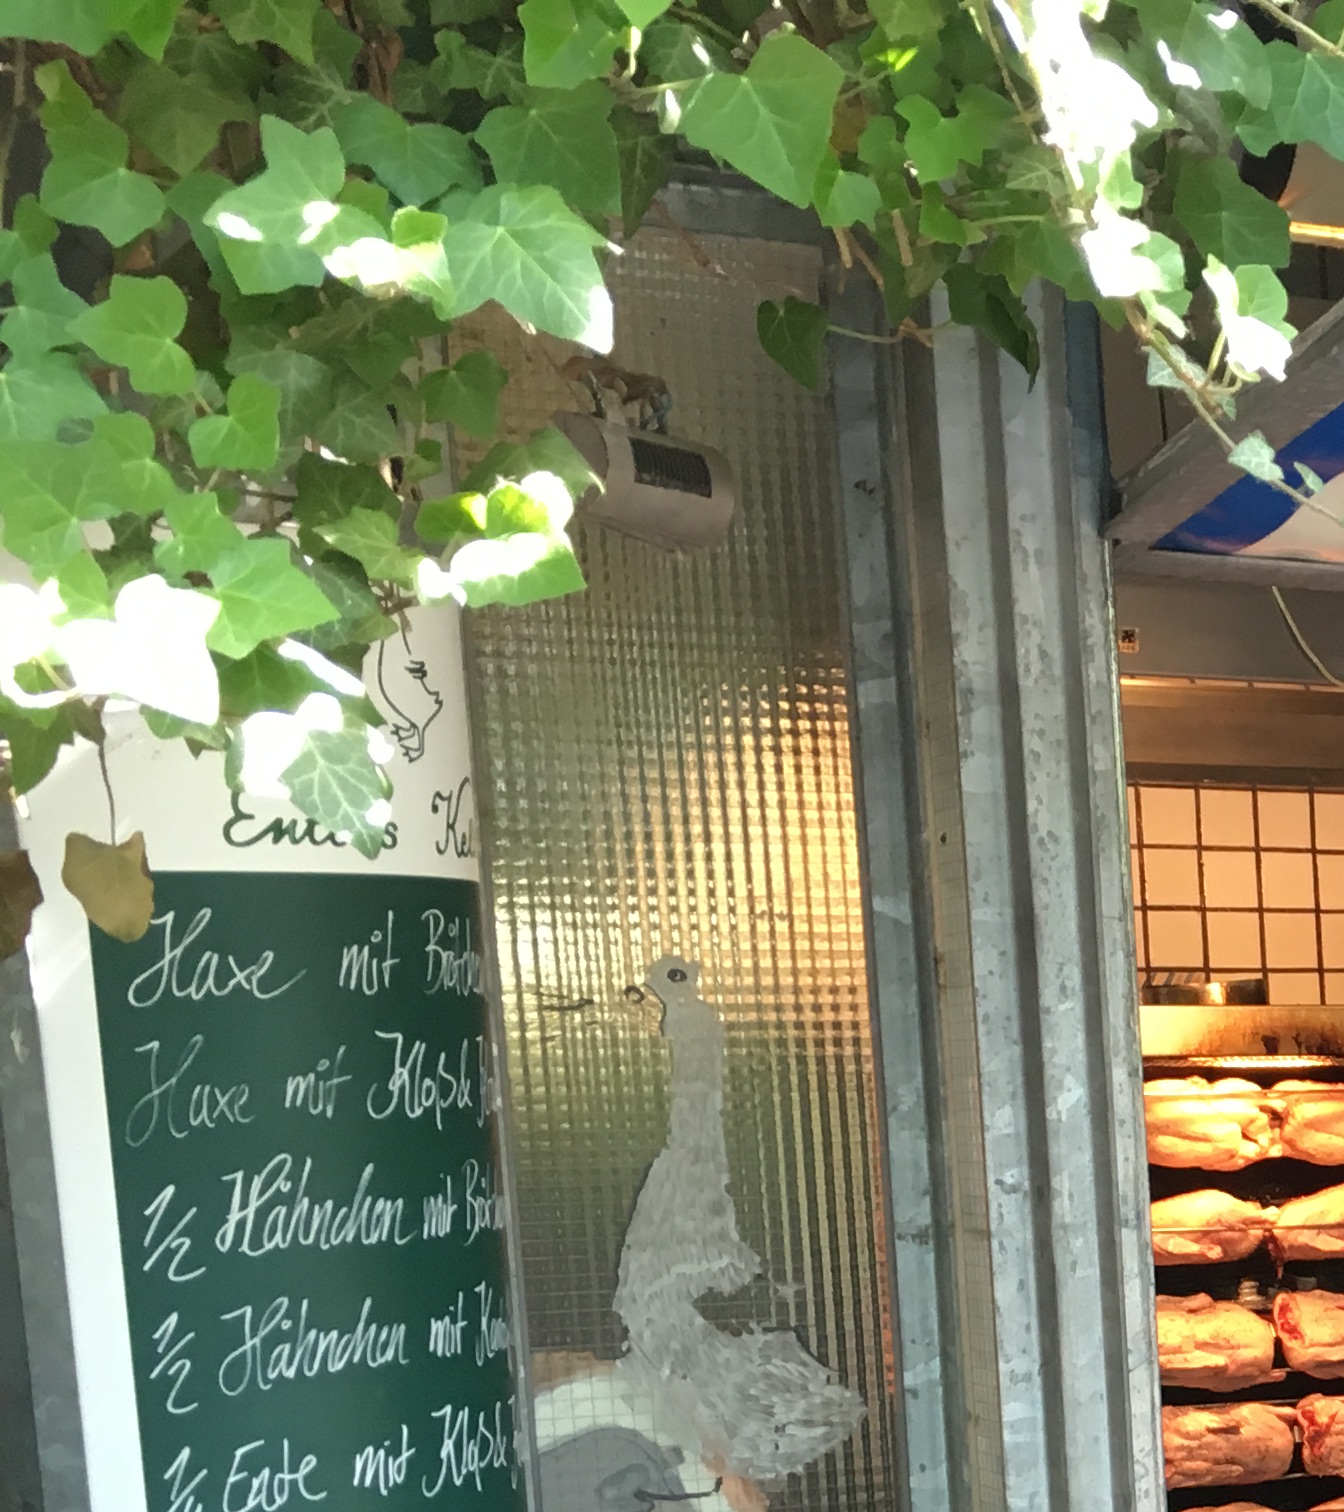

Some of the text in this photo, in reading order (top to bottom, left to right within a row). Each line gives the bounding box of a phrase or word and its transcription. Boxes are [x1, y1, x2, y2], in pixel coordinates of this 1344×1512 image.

[128, 907, 307, 1007] Haxe
[338, 909, 401, 996] mit
[124, 1034, 256, 1147] Haxe
[284, 1044, 352, 1120] mit
[214, 1153, 418, 1257] Hähnchen
[422, 1172, 458, 1240] mit
[218, 1296, 410, 1396] Hähnchen
[428, 1290, 468, 1358] mit
[352, 1424, 416, 1496] mit
